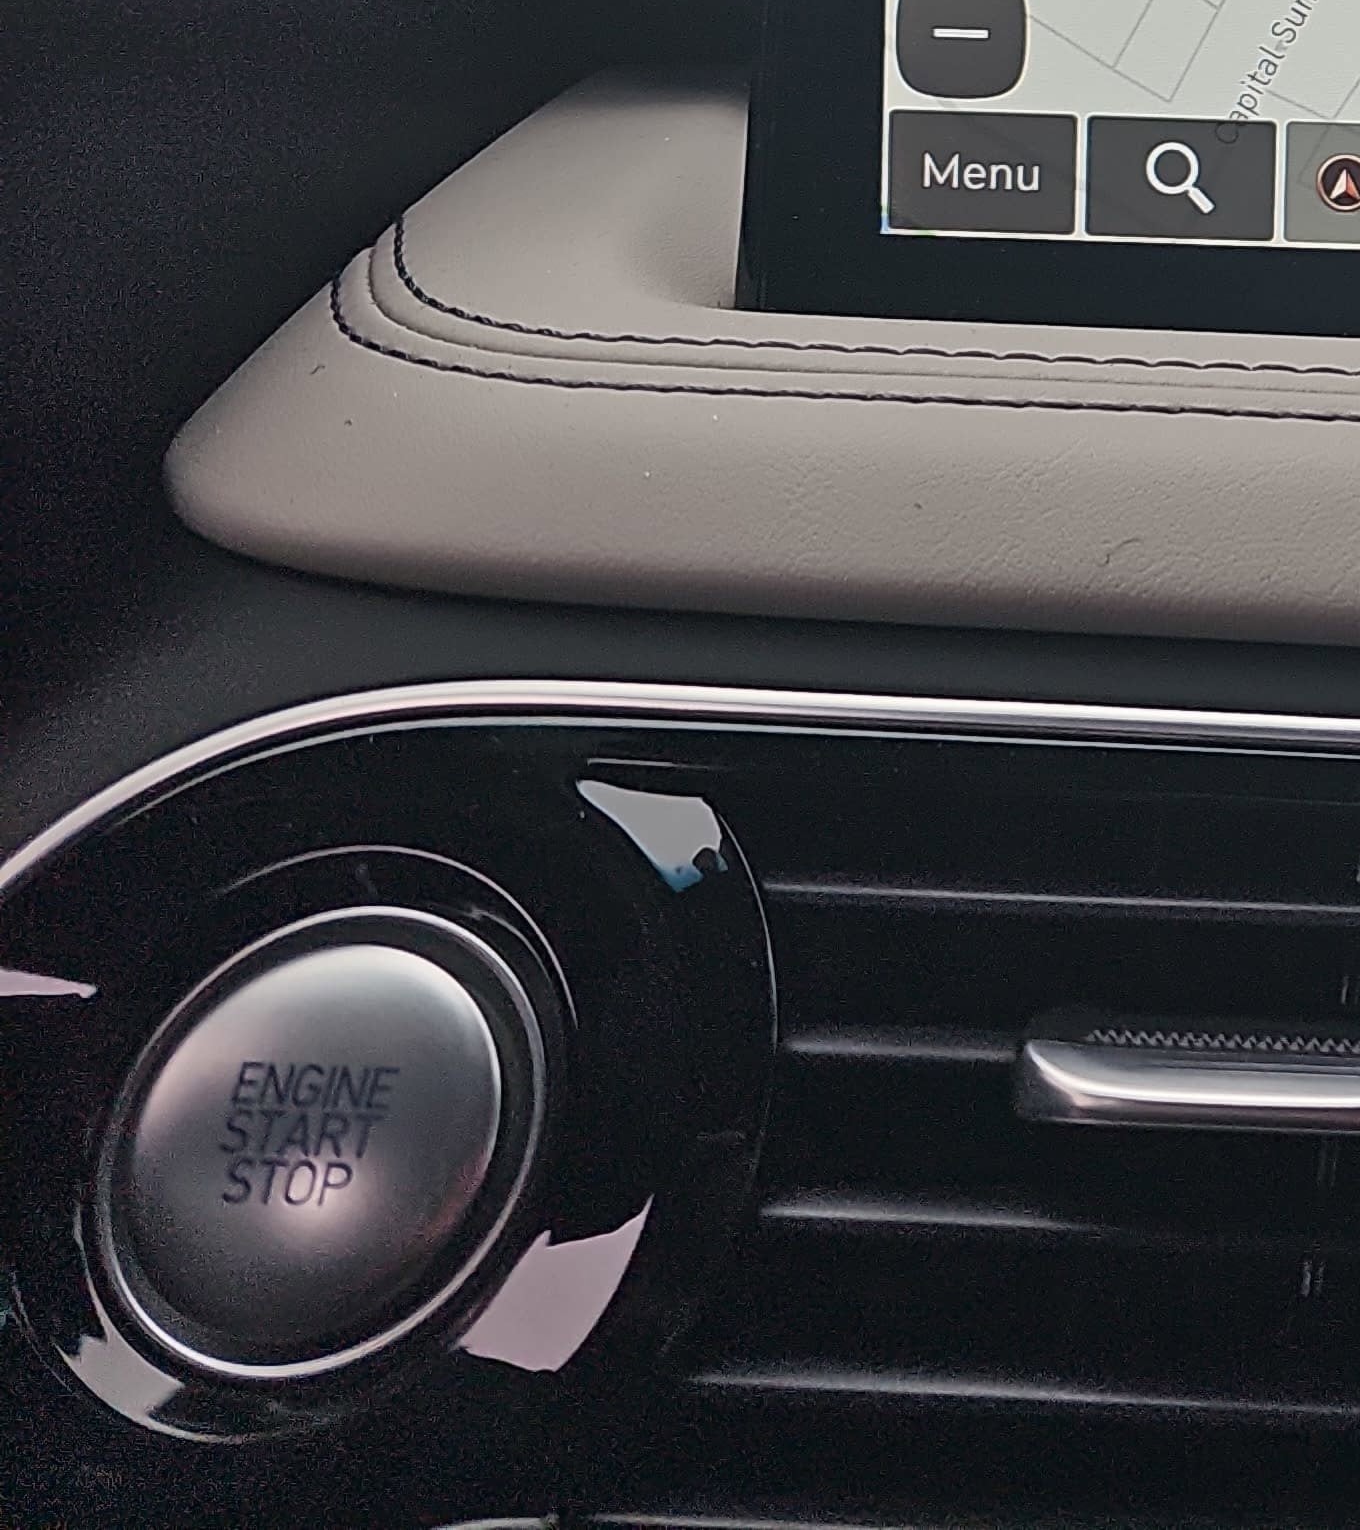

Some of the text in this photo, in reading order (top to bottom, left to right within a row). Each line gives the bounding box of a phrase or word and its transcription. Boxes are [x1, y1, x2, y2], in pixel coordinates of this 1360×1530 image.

[1214, 45, 1285, 144] Capital
[921, 153, 1040, 192] Menu
[232, 1061, 400, 1108] ENGINE
[219, 1108, 385, 1158] START
[222, 1157, 353, 1206] STOP
